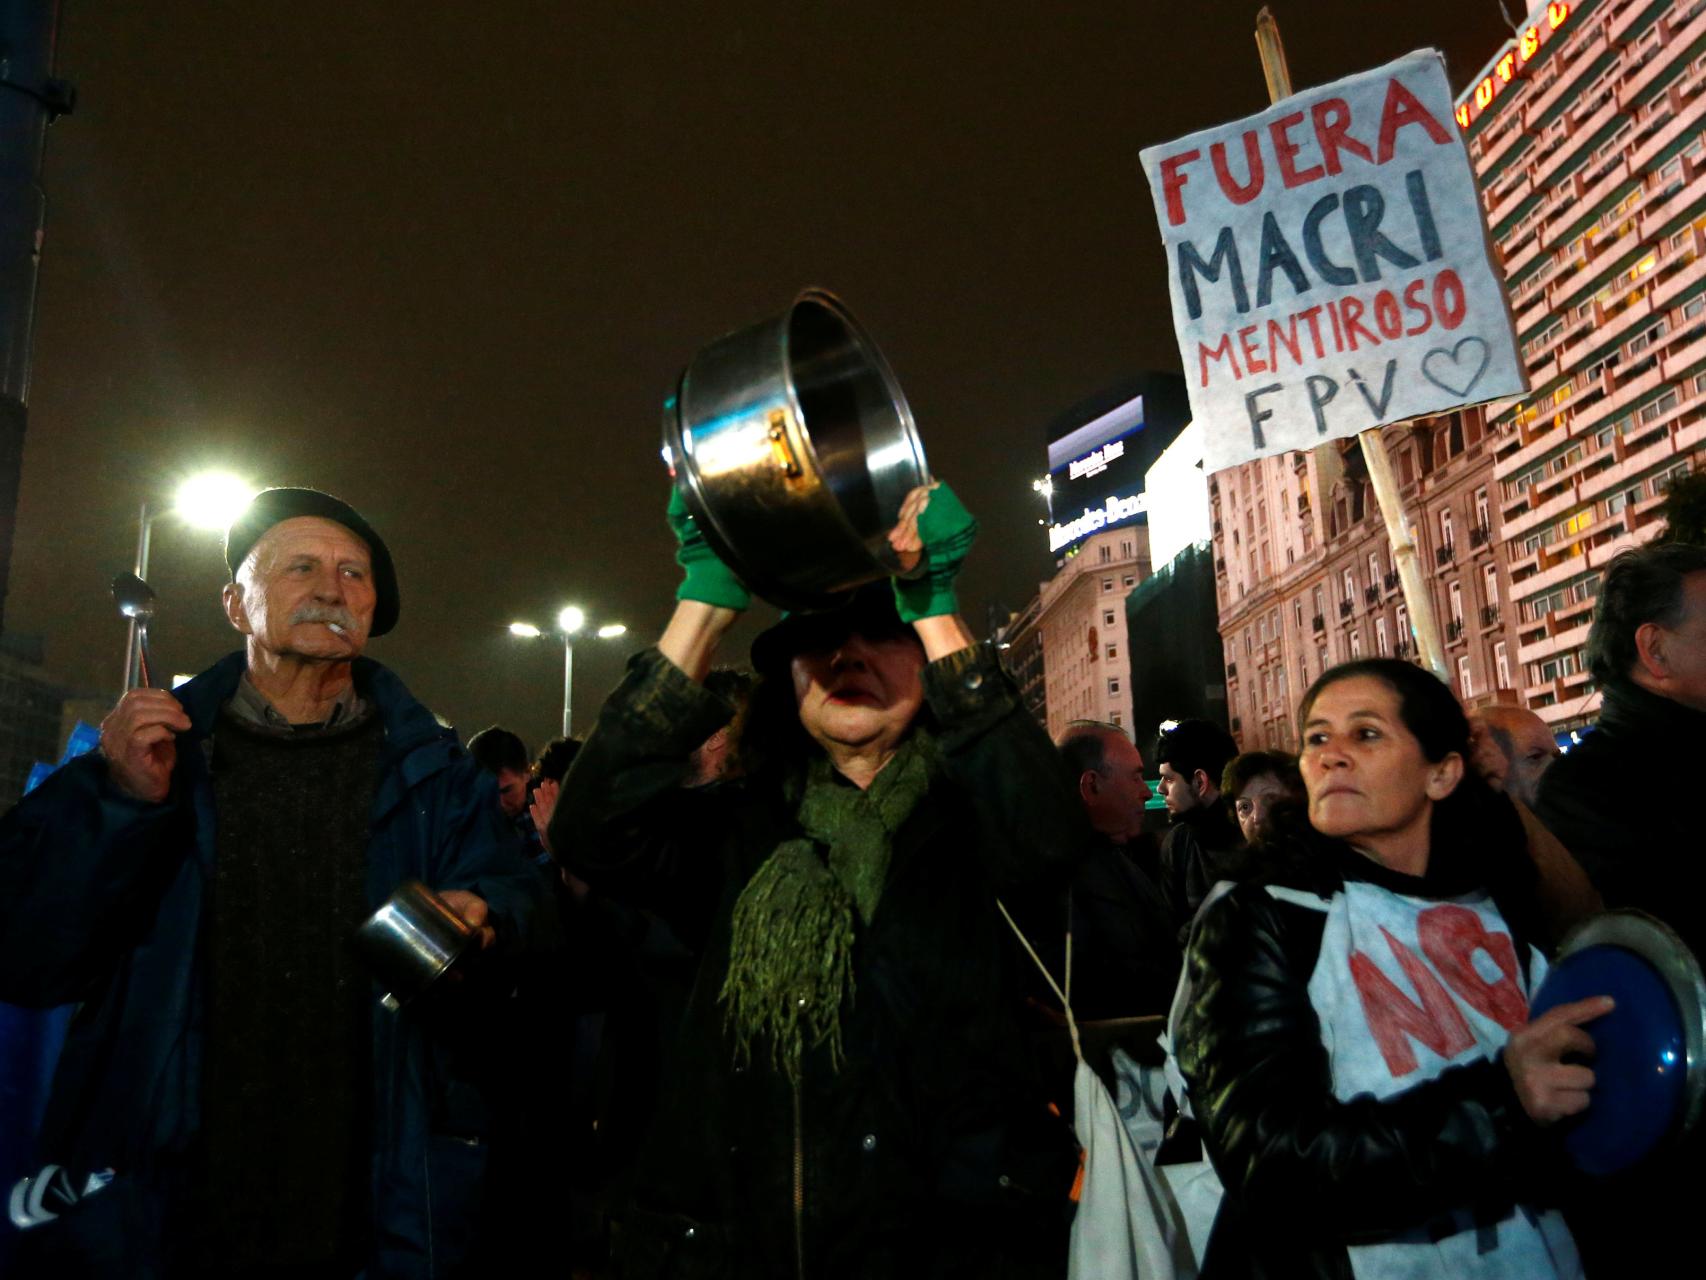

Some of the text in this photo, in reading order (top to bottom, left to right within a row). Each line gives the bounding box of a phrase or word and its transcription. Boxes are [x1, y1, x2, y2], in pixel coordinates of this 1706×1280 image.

[1160, 78, 1454, 226] FUERA
[1177, 170, 1442, 319] MACRI
[1199, 269, 1466, 387] MENTIROSO
